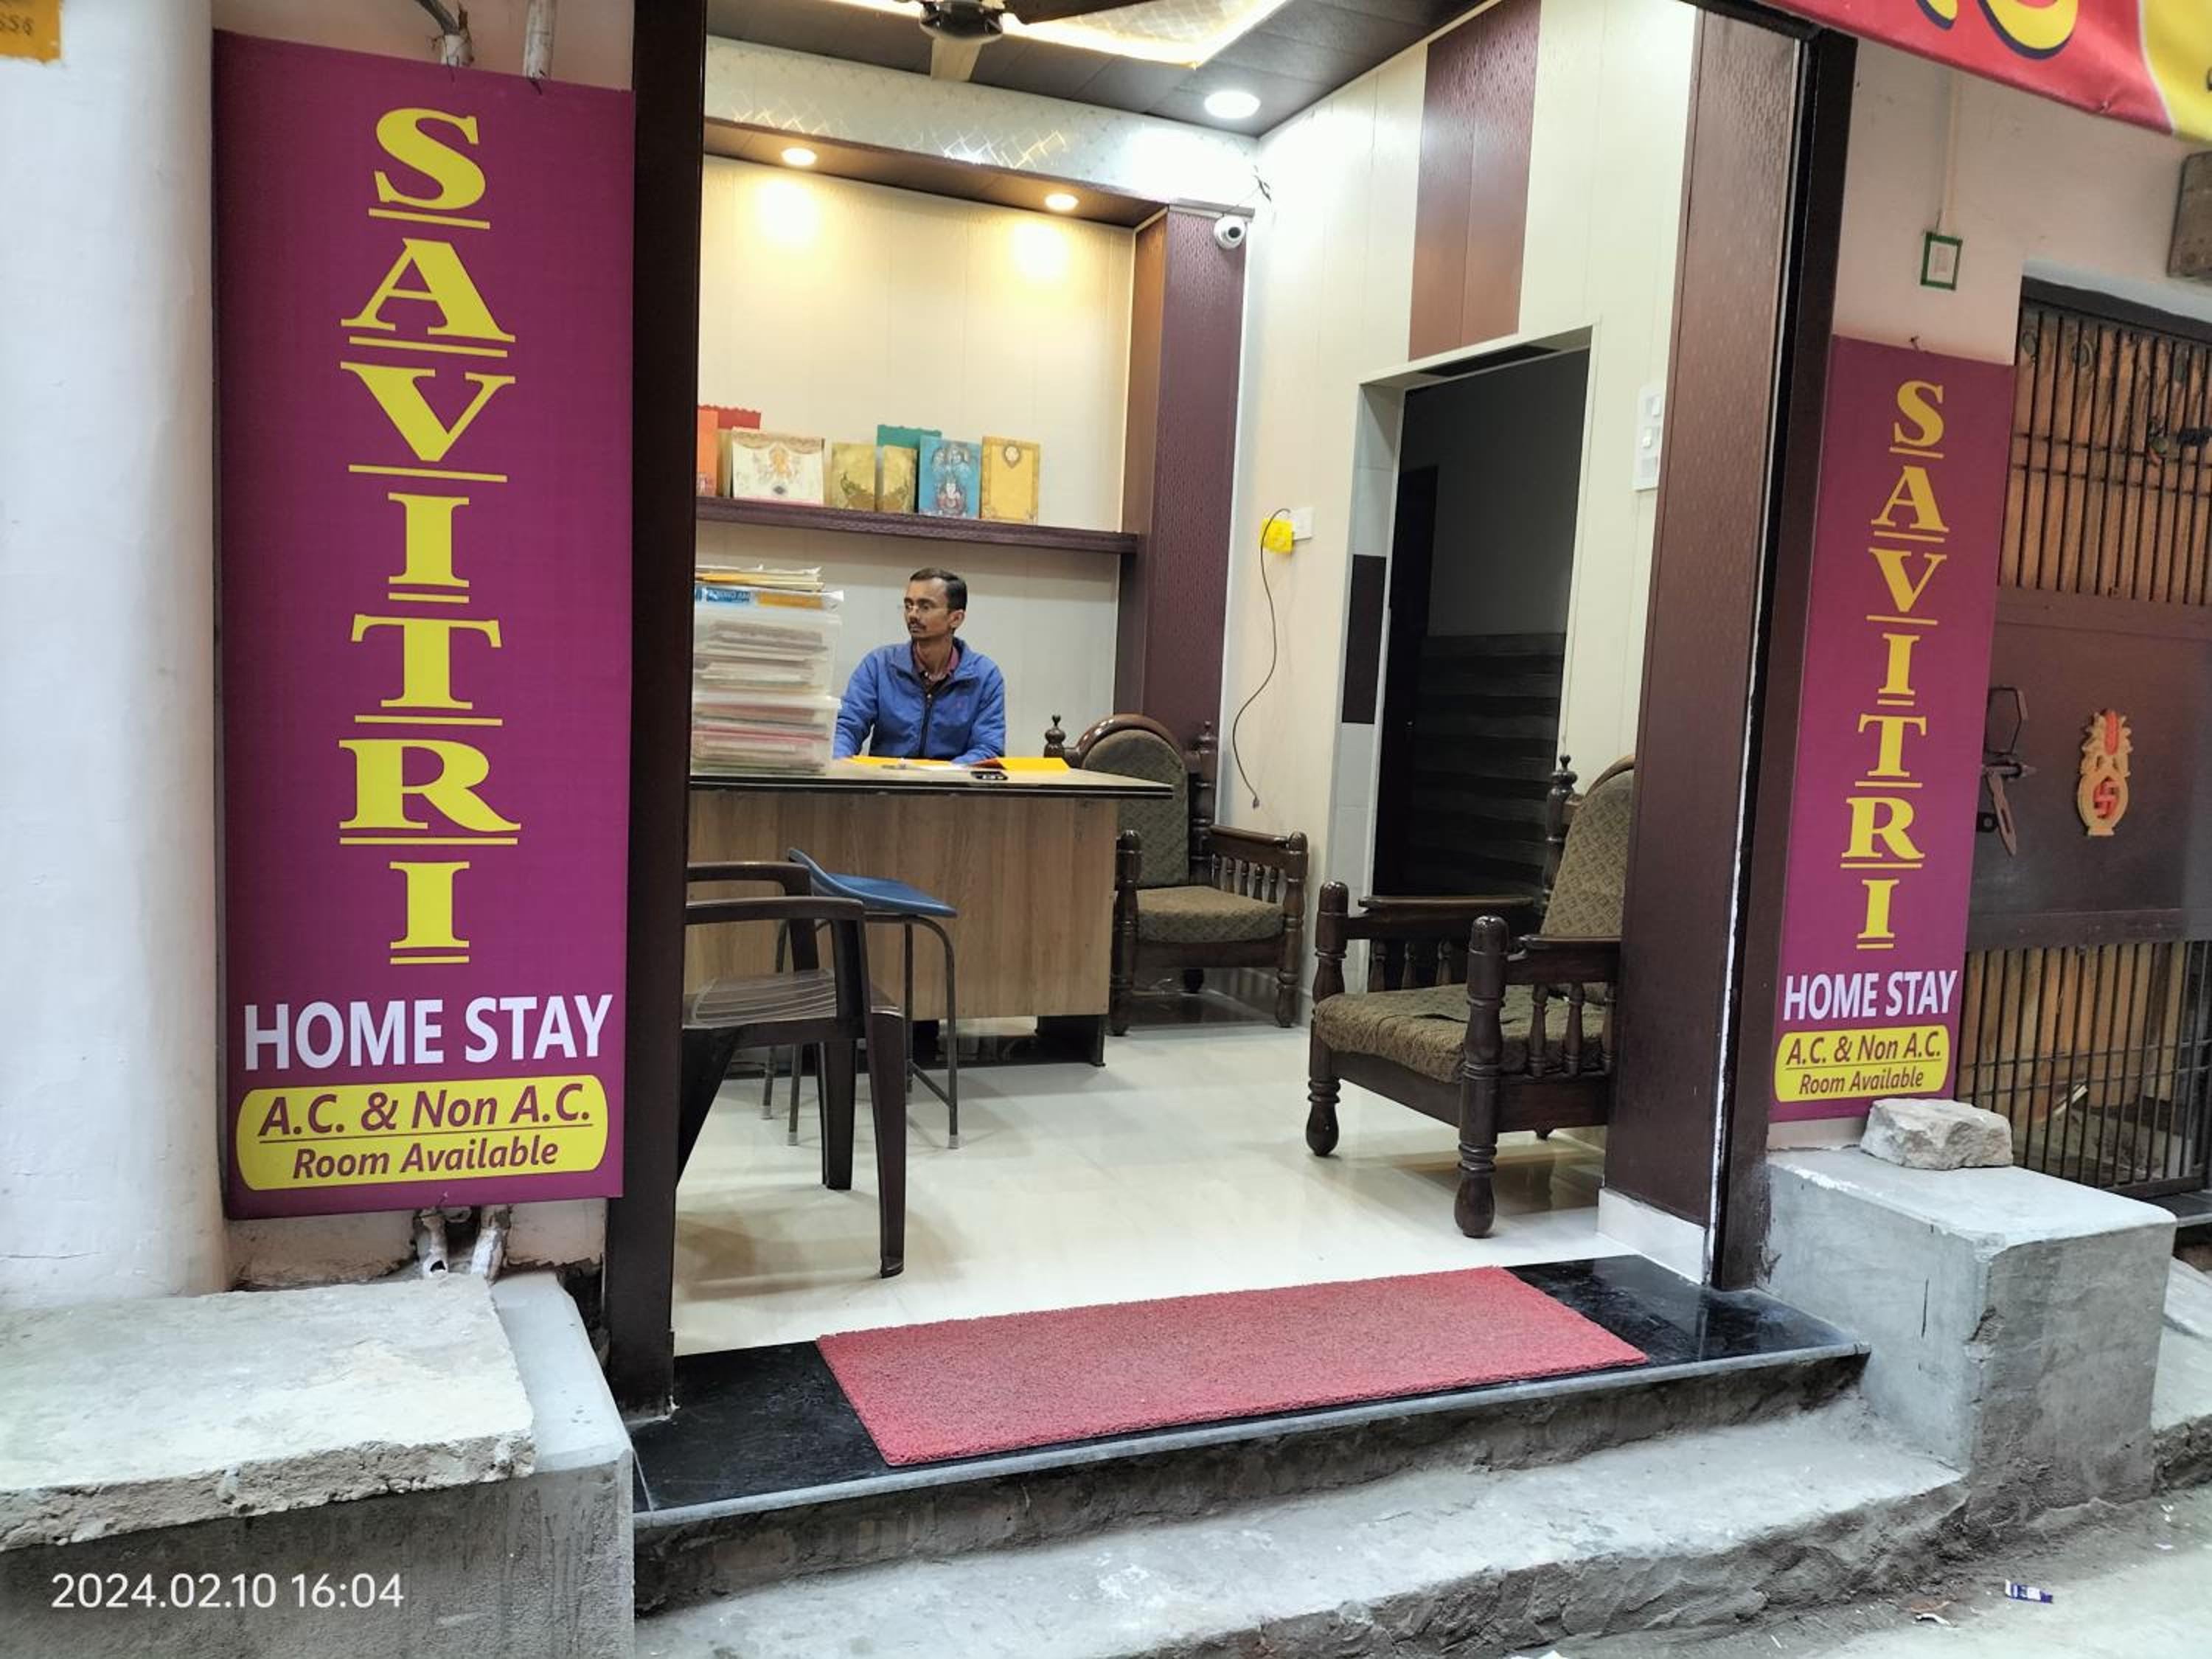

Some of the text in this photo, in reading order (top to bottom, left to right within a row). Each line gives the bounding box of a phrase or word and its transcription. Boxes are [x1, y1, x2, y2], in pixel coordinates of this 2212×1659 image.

[339, 108, 521, 950] SAVITRI
[1841, 380, 1950, 939] SAVITRI
[1783, 970, 1958, 1021] HOME STAY
[244, 994, 613, 1071] HOME STAY
[1785, 1031, 1941, 1065] A.C. & Non A.C.
[1798, 1066, 1924, 1095] Room Available
[257, 1082, 591, 1136] A.C. & Non A.C.
[292, 1135, 559, 1179] Room Available
